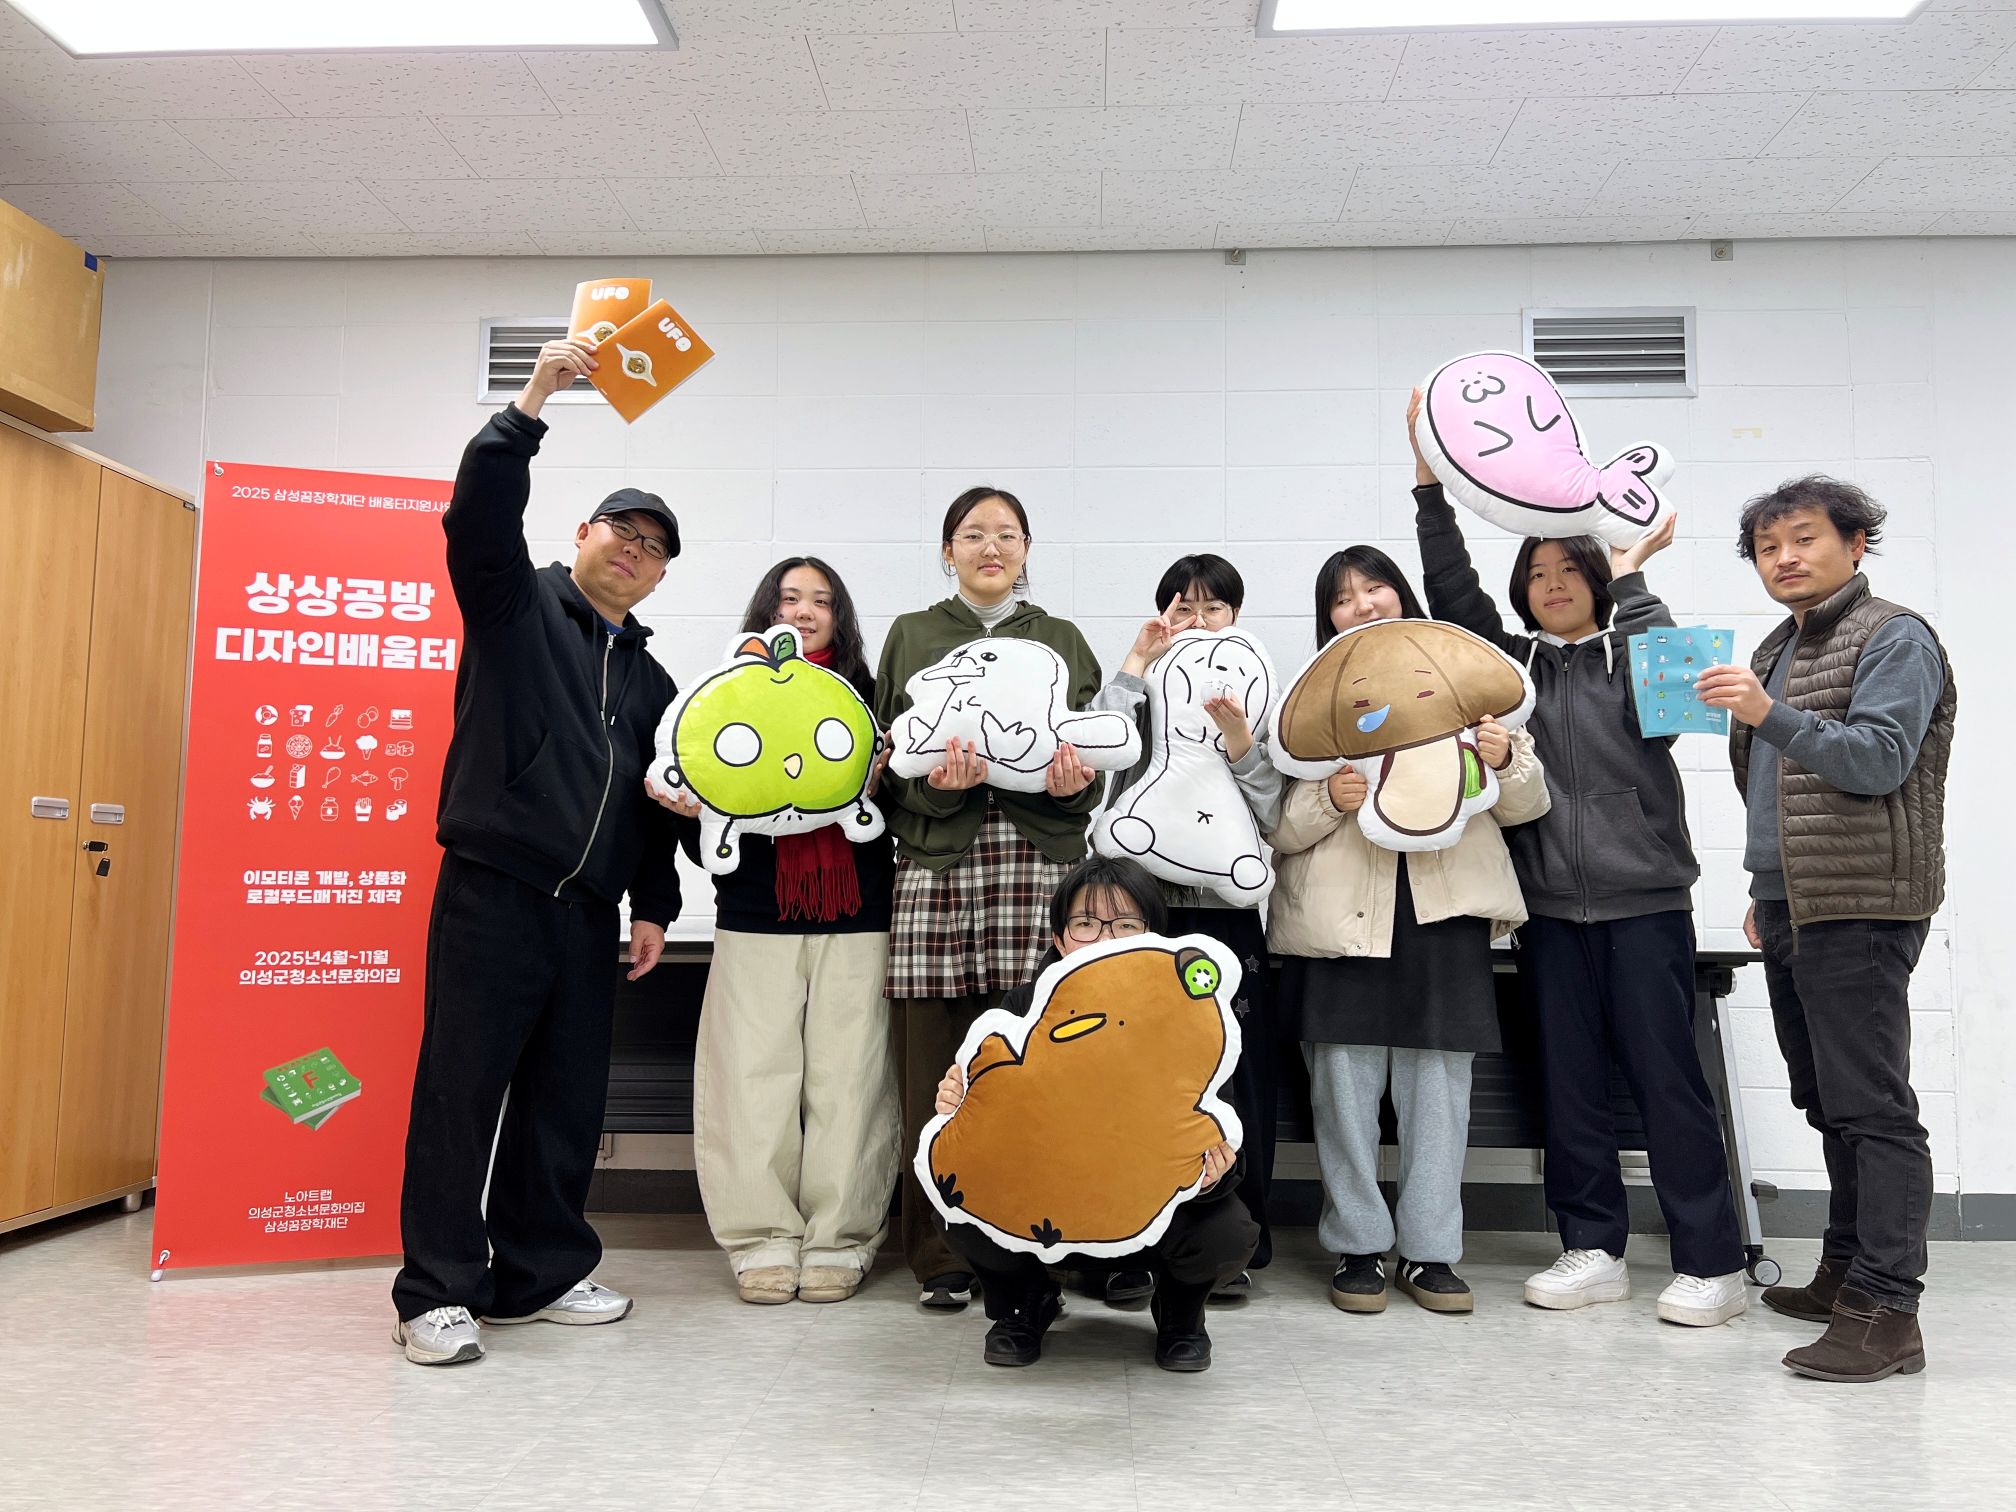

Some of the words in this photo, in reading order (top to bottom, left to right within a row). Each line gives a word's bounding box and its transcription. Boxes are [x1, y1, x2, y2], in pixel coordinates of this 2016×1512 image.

[592, 286, 629, 300] UFO
[658, 317, 692, 352] UFO
[231, 485, 270, 500] 2025
[274, 489, 365, 508] 삼성꿈장학재단
[244, 571, 435, 622] 상상공방
[215, 626, 457, 671] 디자인배움터
[243, 870, 310, 885] 이모티콘
[315, 870, 354, 888] 개발,
[358, 870, 407, 885] 상품화
[246, 889, 363, 904] 로컬푸드매거진
[368, 888, 402, 904] 제작
[255, 950, 389, 966] 2025년4월~11월
[239, 968, 401, 985] 의성군청소년문화의집
[301, 1071, 319, 1089] F
[284, 1189, 332, 1204] 노아트랩
[248, 1202, 366, 1219] 의성군청소년문화의집
[264, 1217, 349, 1233] 삼성꿈장학재단
